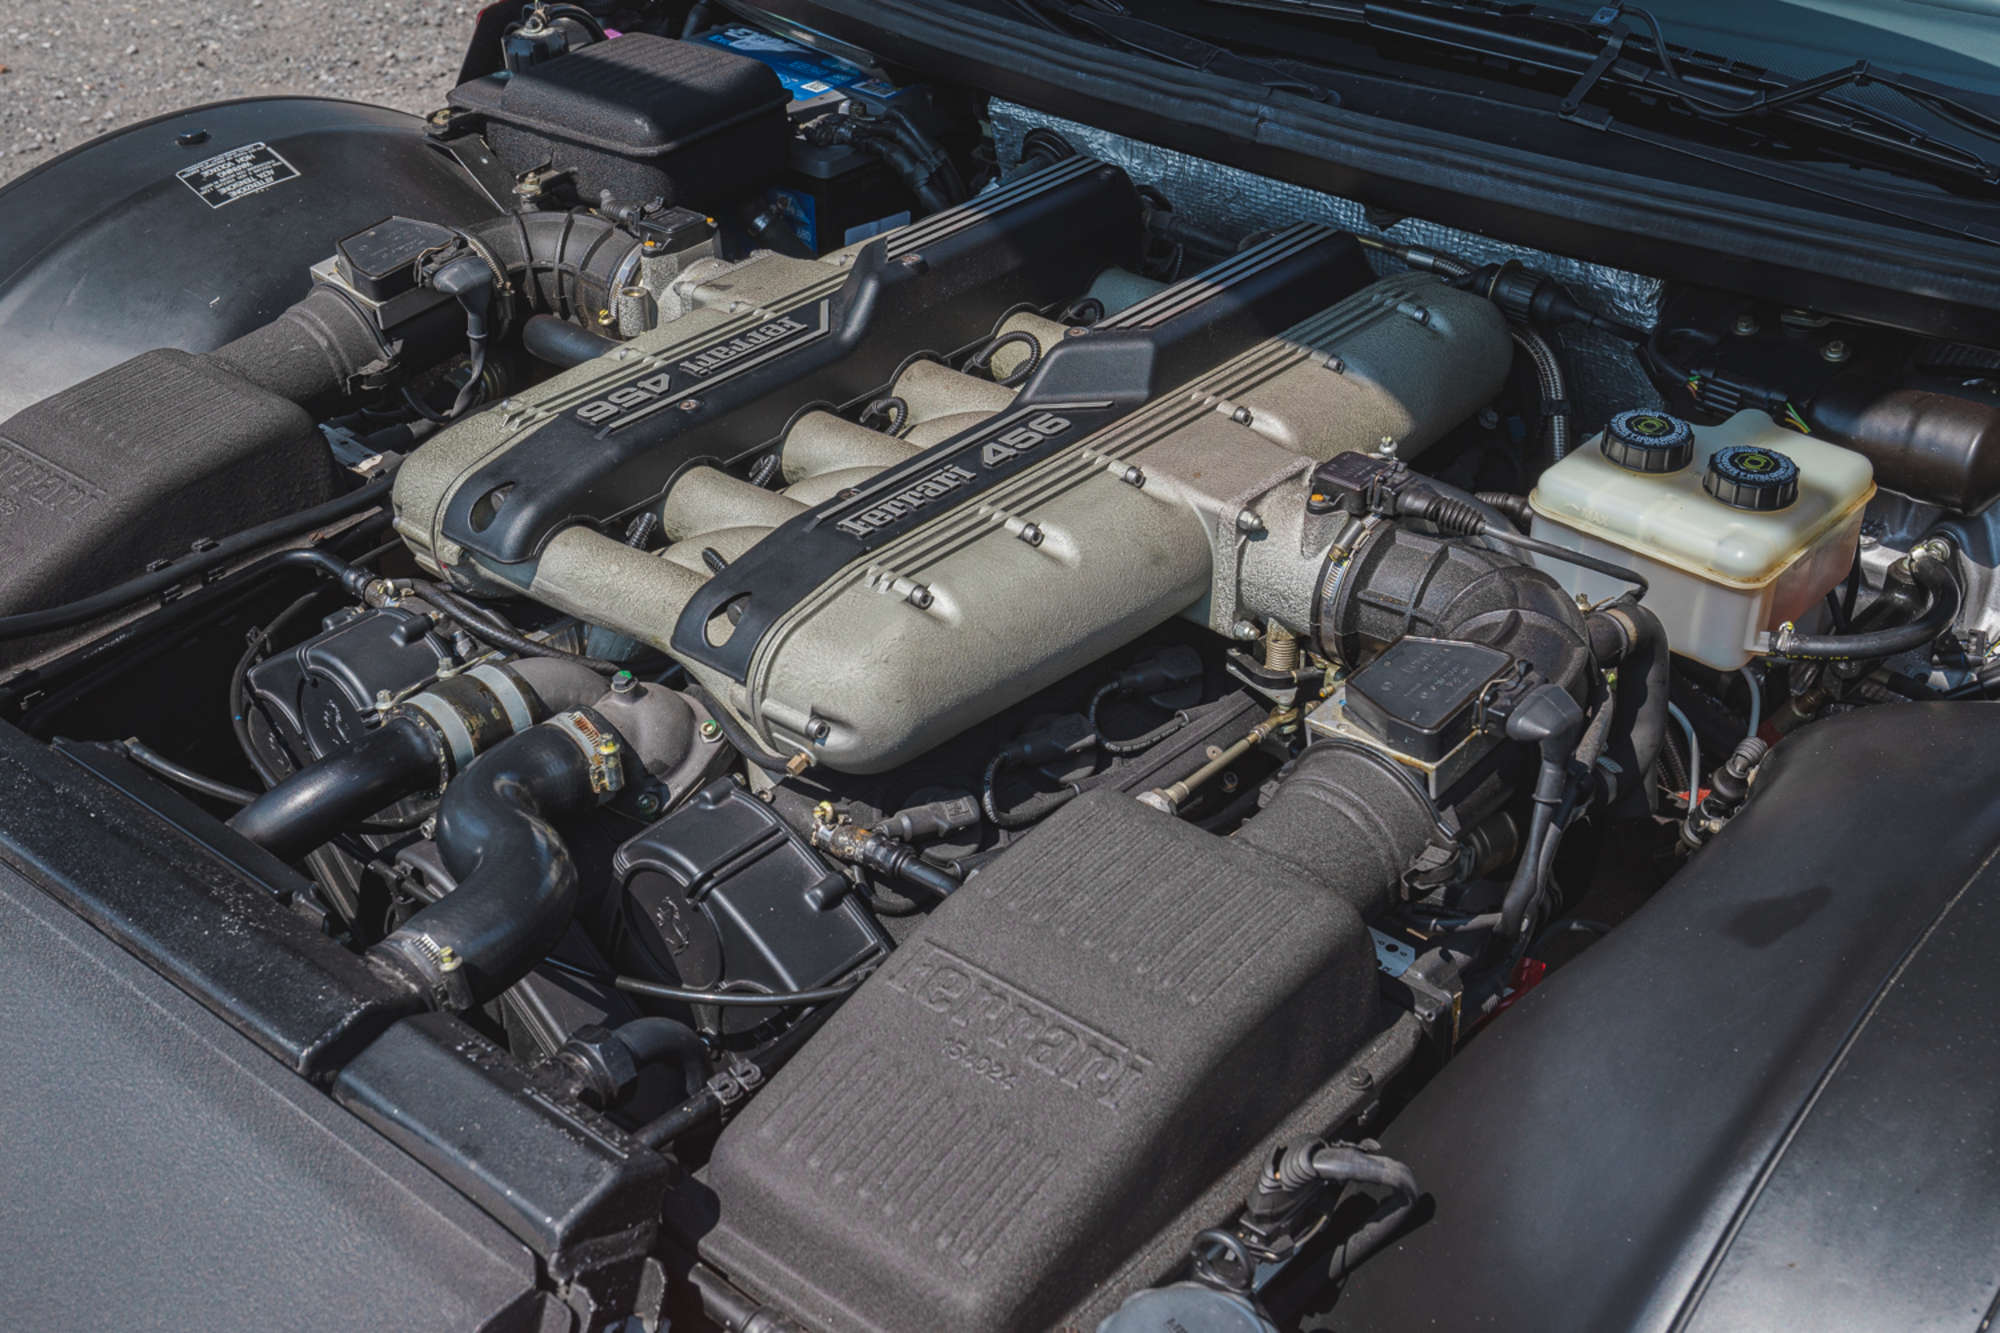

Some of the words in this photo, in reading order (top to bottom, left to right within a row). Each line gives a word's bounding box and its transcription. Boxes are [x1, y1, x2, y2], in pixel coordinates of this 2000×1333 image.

[680, 316, 809, 376] Ferrari
[576, 372, 673, 424] 456
[836, 463, 977, 538] Ferrari
[982, 412, 1072, 467] 456
[886, 938, 1153, 1109] Ferrari
